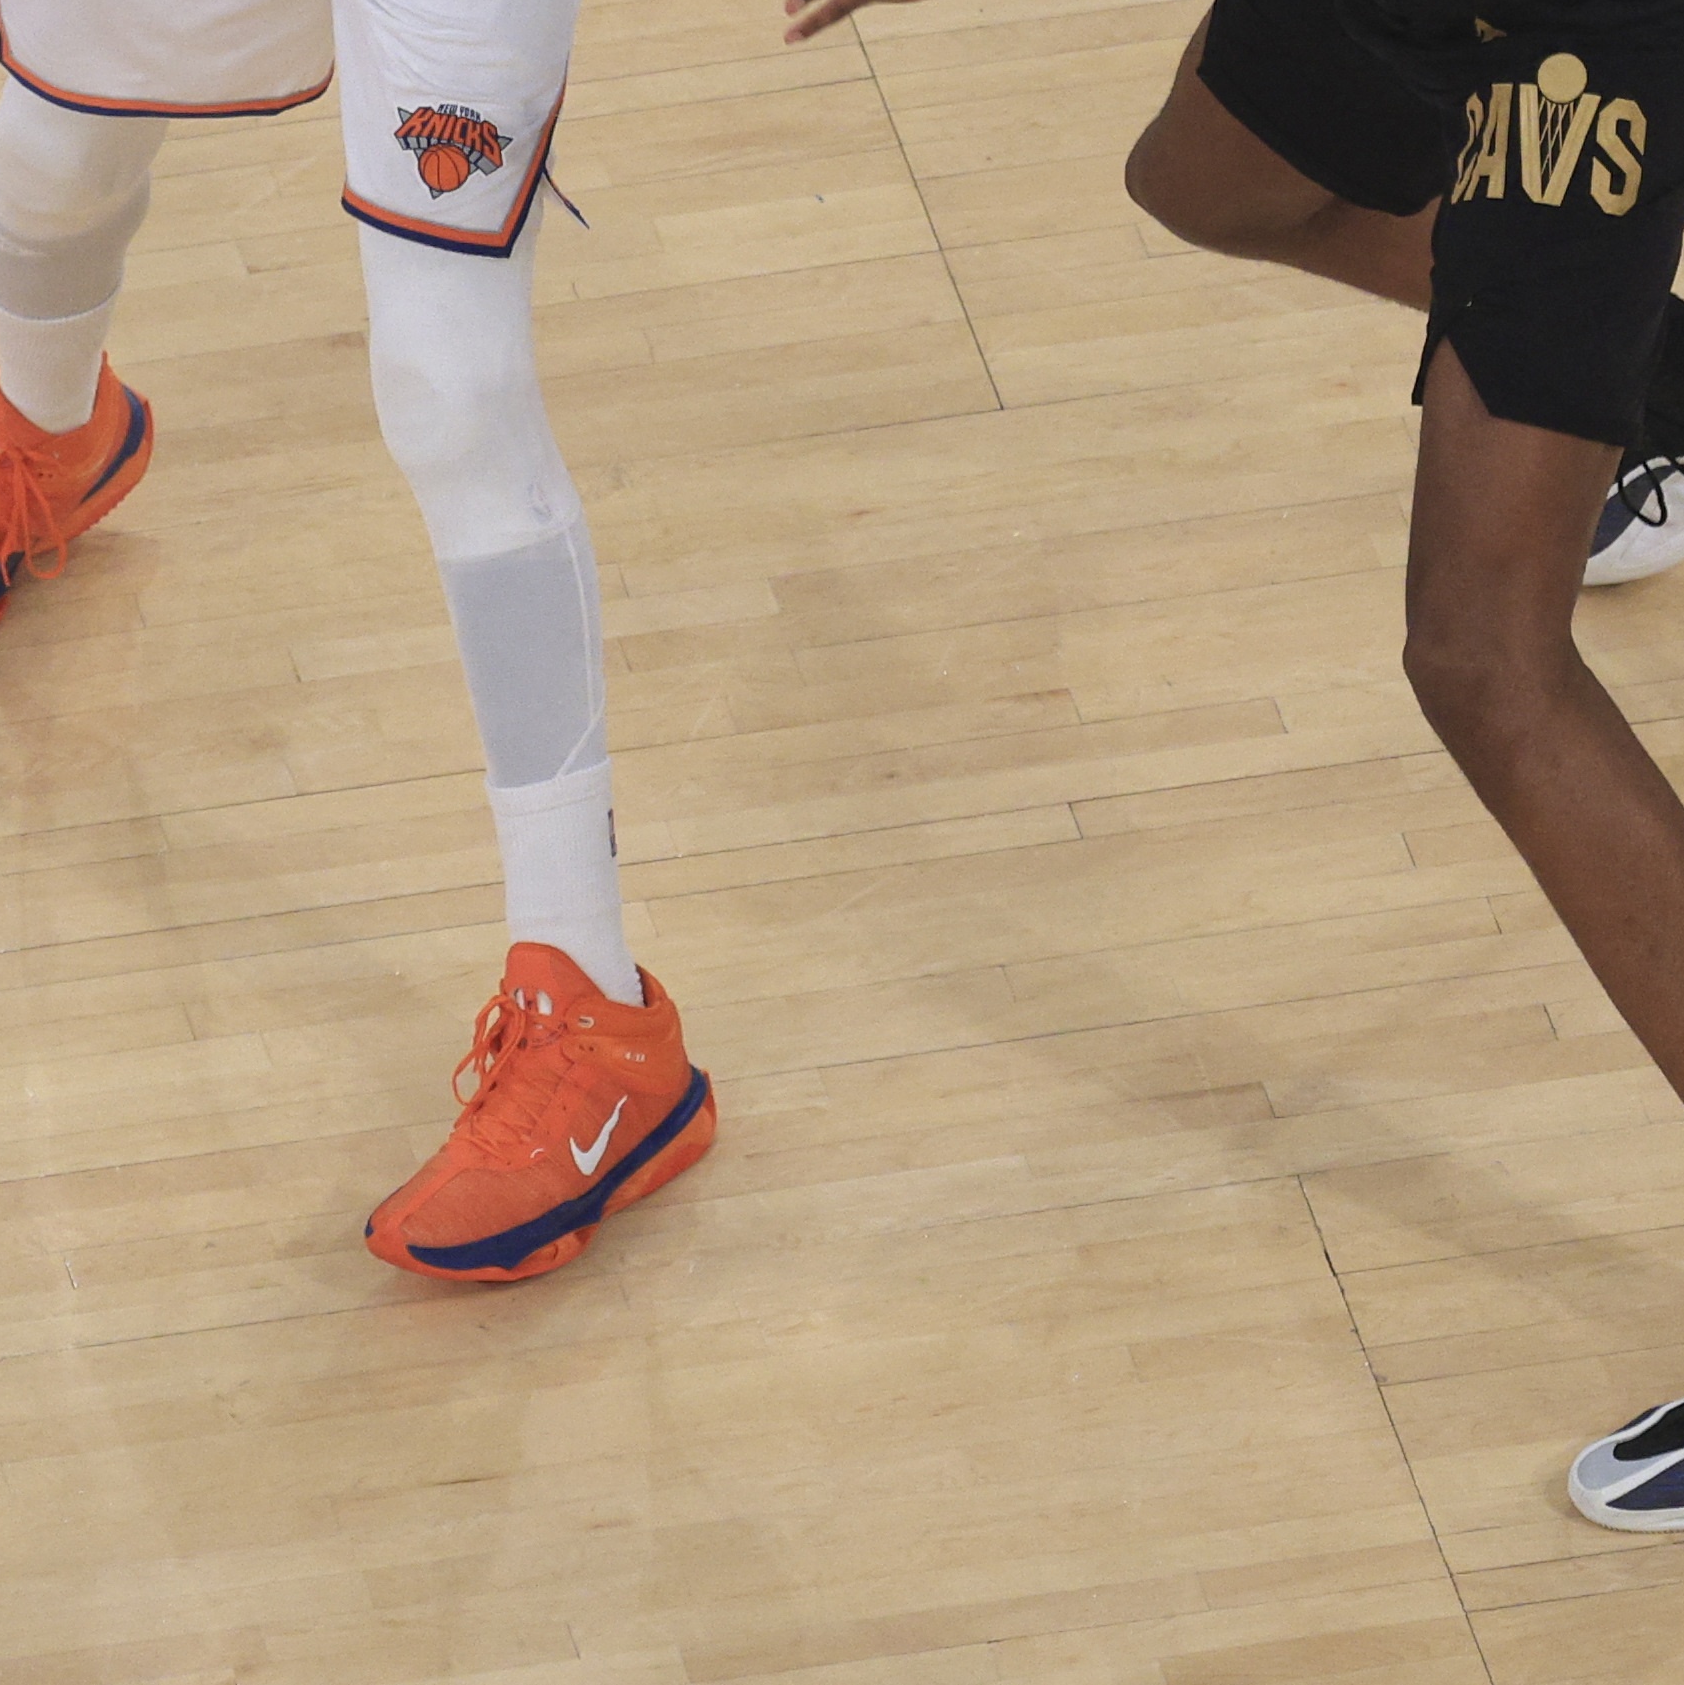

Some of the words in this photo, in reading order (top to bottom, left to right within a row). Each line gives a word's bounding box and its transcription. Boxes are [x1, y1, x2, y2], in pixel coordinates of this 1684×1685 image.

[437, 103, 459, 115] NEW
[459, 105, 482, 122] YORK
[394, 107, 503, 171] KNICKS
